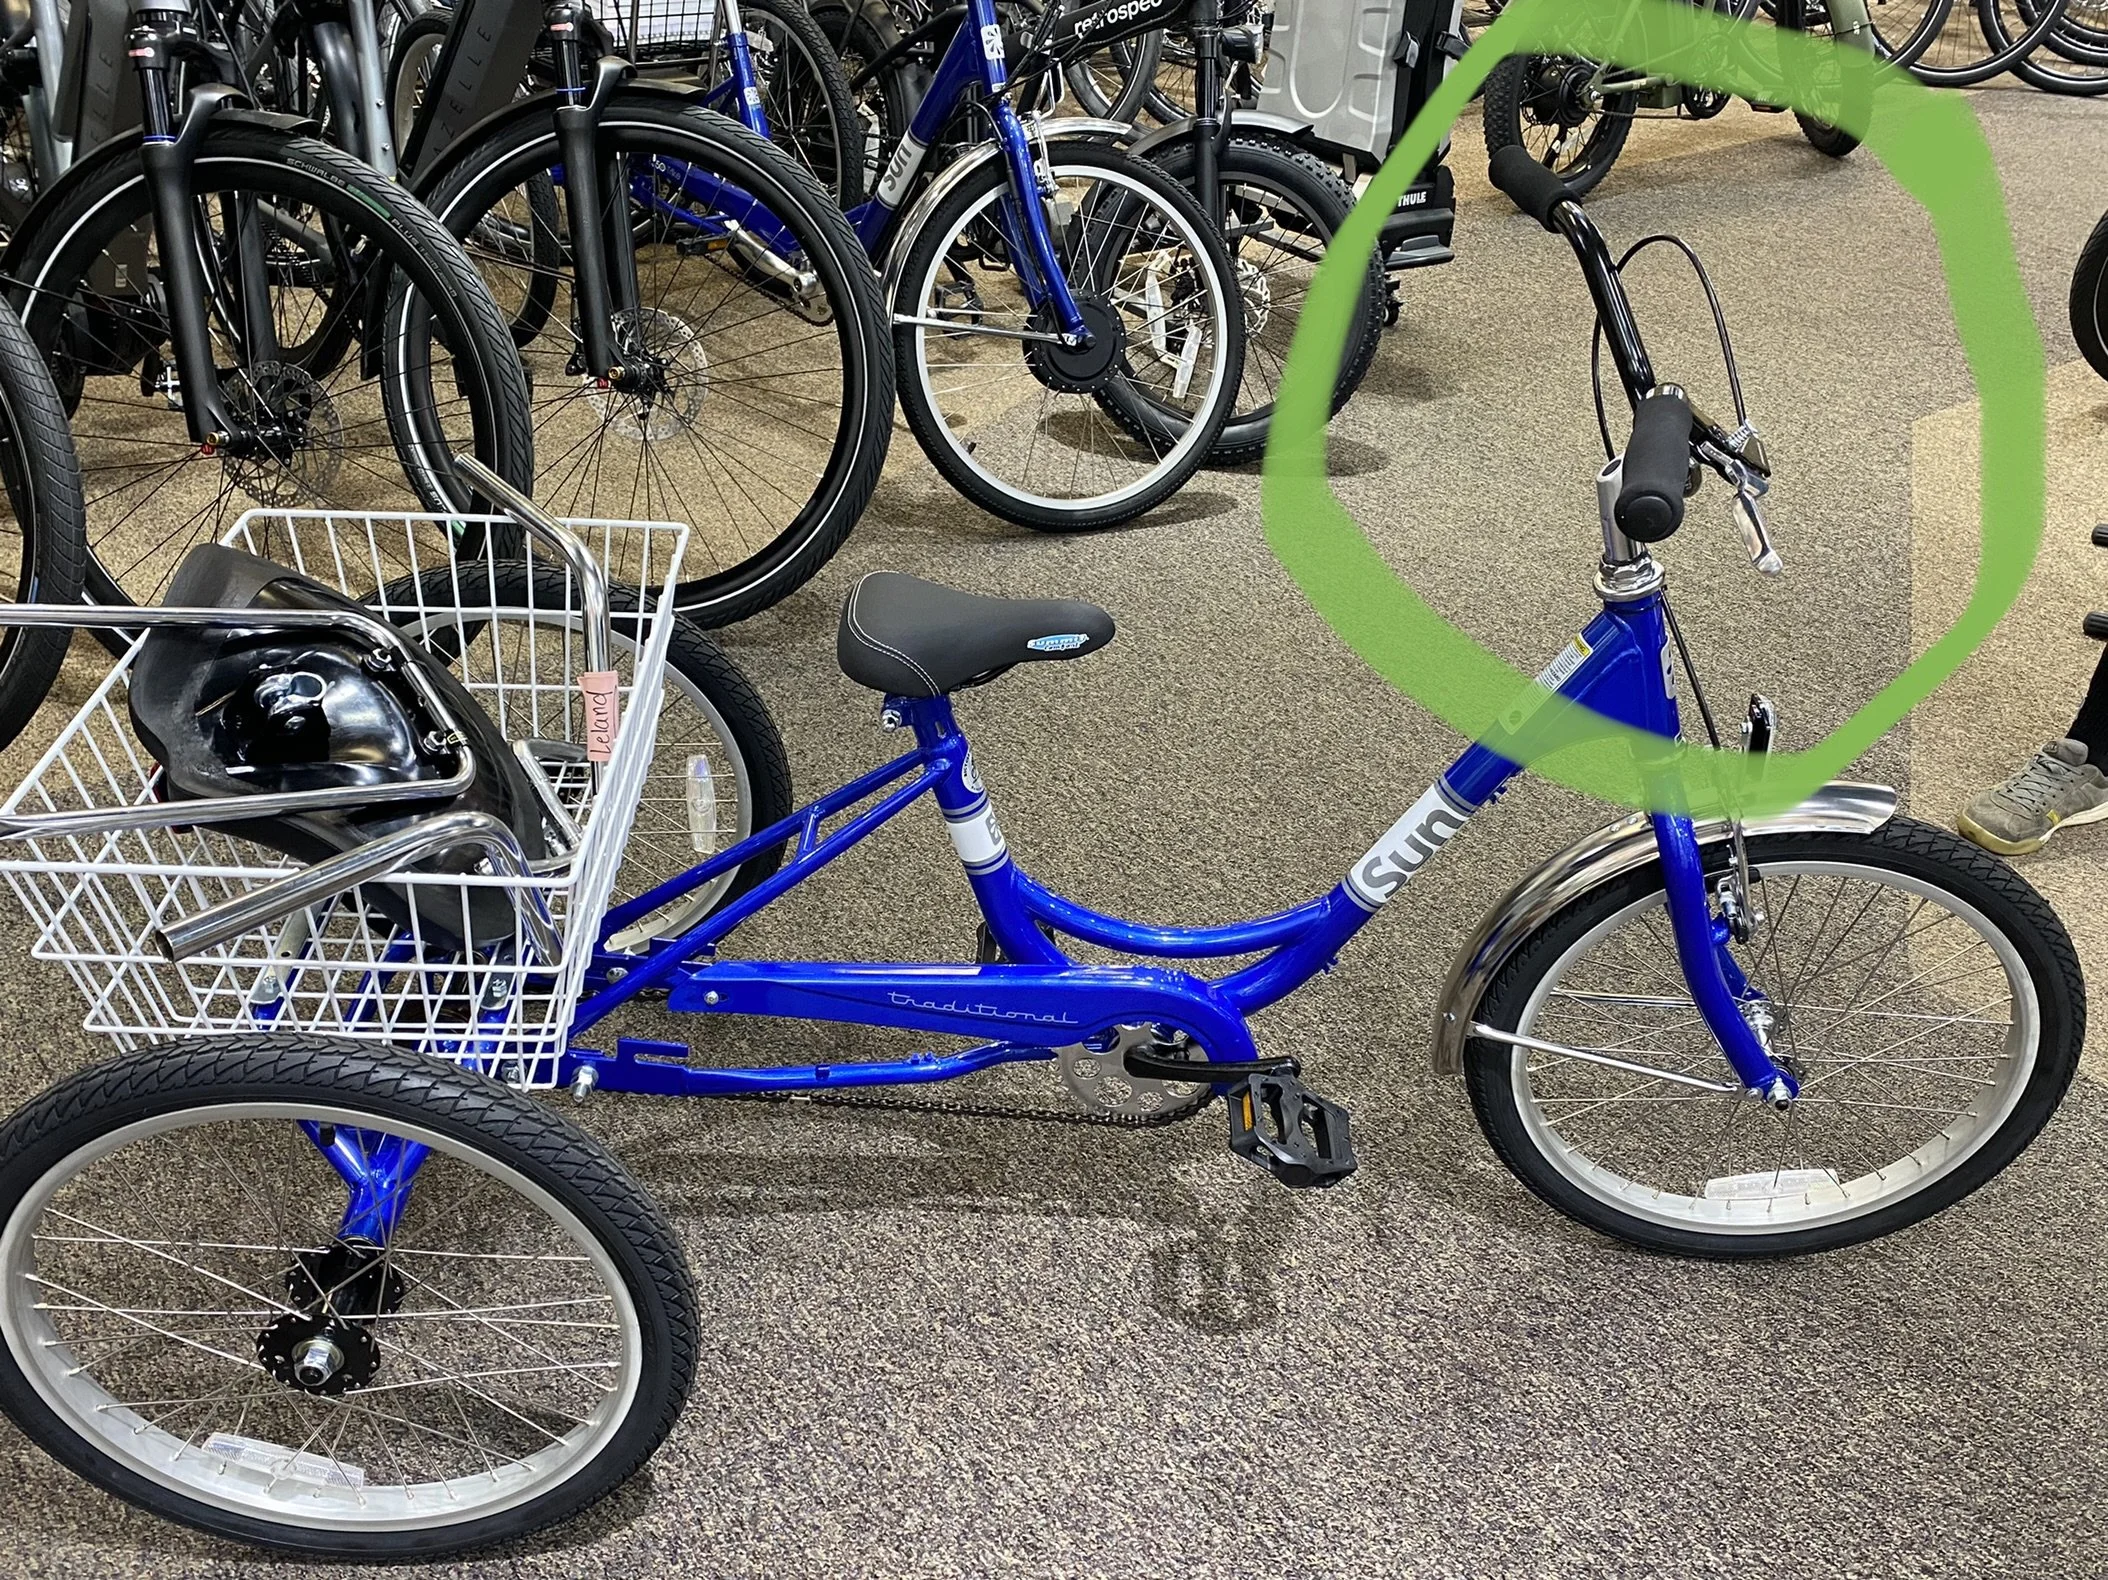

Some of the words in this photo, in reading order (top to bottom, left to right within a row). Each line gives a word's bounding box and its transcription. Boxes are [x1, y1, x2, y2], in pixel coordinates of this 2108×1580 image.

[286, 157, 347, 189] SCHWALBE
[1397, 191, 1427, 207] THULE
[585, 690, 614, 754] Leland
[1361, 808, 1466, 899] Sun
[887, 991, 1079, 1025] traditional
